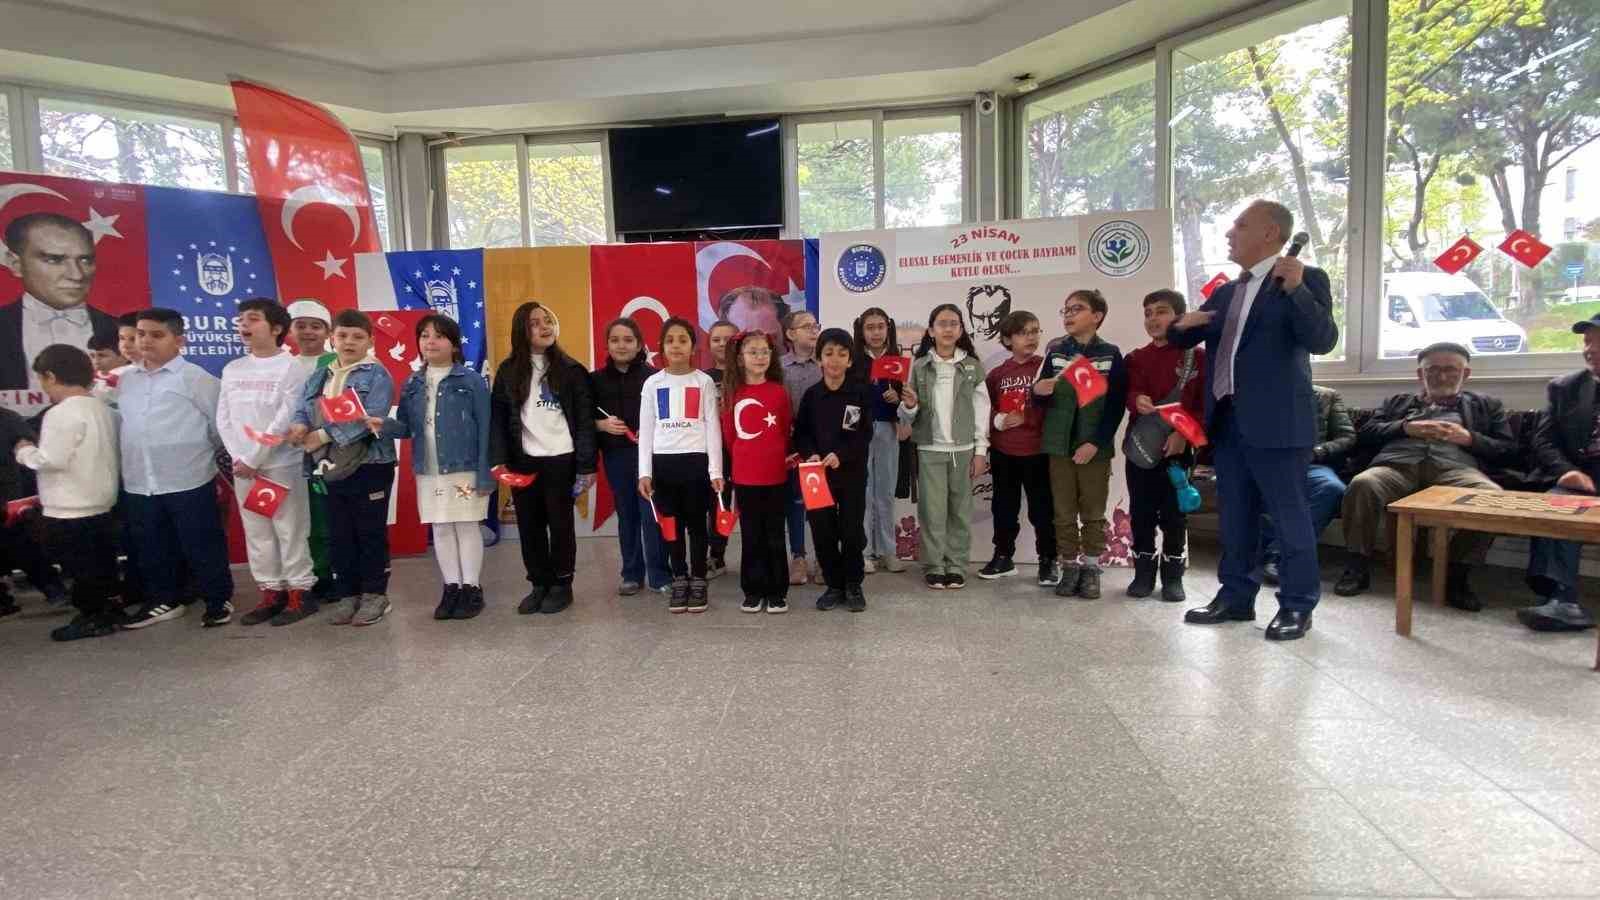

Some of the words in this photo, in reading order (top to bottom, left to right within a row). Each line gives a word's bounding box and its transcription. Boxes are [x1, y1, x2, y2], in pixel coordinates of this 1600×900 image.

[951, 234, 968, 248] 23
[971, 226, 1020, 244] NİSAN
[986, 251, 998, 262] VE
[951, 266, 979, 278] KUTLU
[179, 343, 251, 355] BELEDİYE
